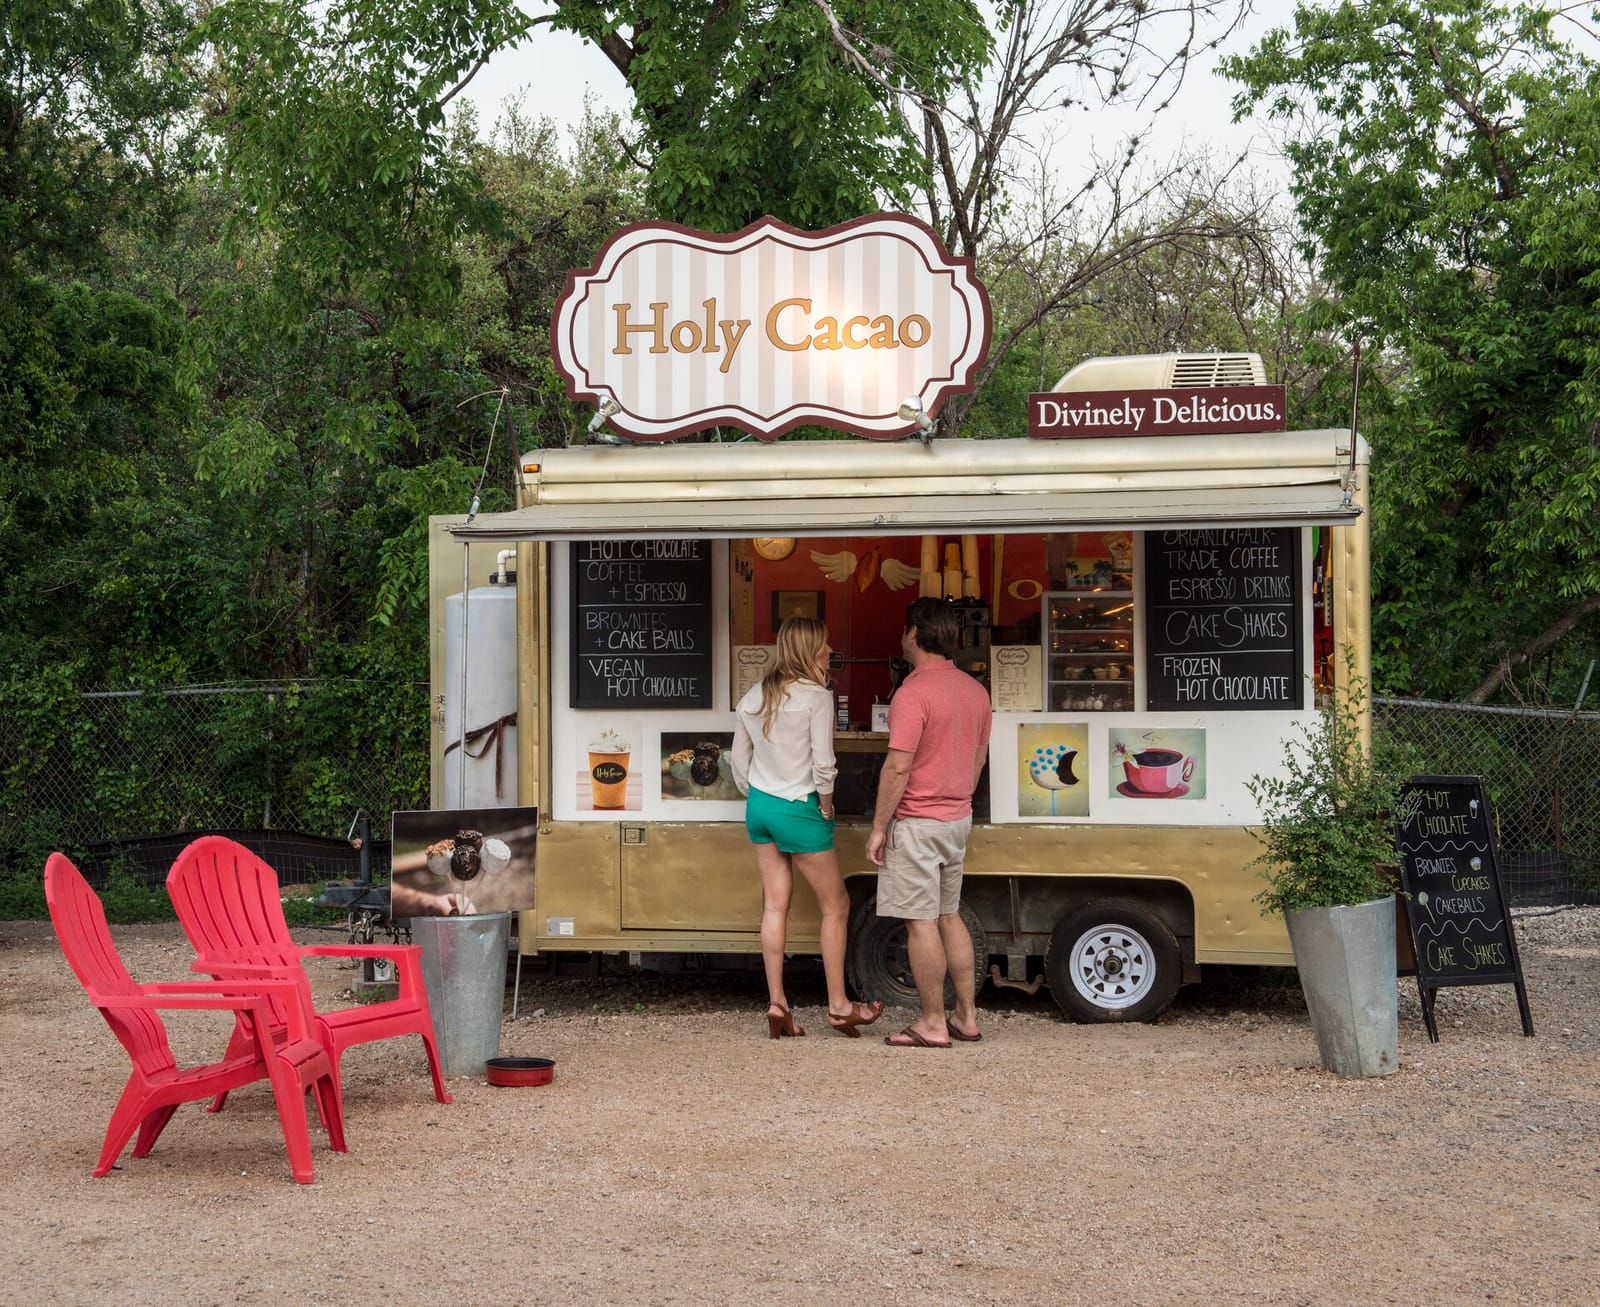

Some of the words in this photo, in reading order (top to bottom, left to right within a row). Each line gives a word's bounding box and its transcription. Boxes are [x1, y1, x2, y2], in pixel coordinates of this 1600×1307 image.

[612, 297, 751, 373] Holy
[765, 297, 932, 351] Cacao
[1037, 397, 1146, 431] Divinely
[1153, 395, 1281, 425] Delicious.
[589, 540, 626, 559] HOT
[630, 540, 699, 558] CHOCOLATE
[1163, 550, 1219, 570] TRADE
[1229, 547, 1279, 568] COFFEE
[586, 562, 646, 581] COFFEE
[608, 587, 620, 599] +
[625, 582, 687, 601] ESPRESSO
[1169, 576, 1236, 600] ESPRESSO
[1244, 576, 1291, 598] DRINKS
[586, 612, 667, 630] BROWNIES
[594, 637, 605, 647] +
[608, 630, 647, 649] CAKE
[653, 629, 694, 650] BALLS
[588, 658, 644, 678] VEGAN
[1163, 657, 1221, 677] FROZEN
[607, 677, 640, 697] HOT
[642, 677, 699, 697] CHOCOLATE
[1177, 678, 1208, 701] HOT
[1212, 676, 1289, 700] CHOCOLATE
[1425, 790, 1450, 810] HOT
[1417, 811, 1470, 838] CHOCOLATE
[1415, 857, 1457, 877] BROWNIES
[1452, 875, 1490, 892] CUPCAKES
[1427, 939, 1457, 972] CAKE
[1462, 937, 1505, 970] SHAKES
